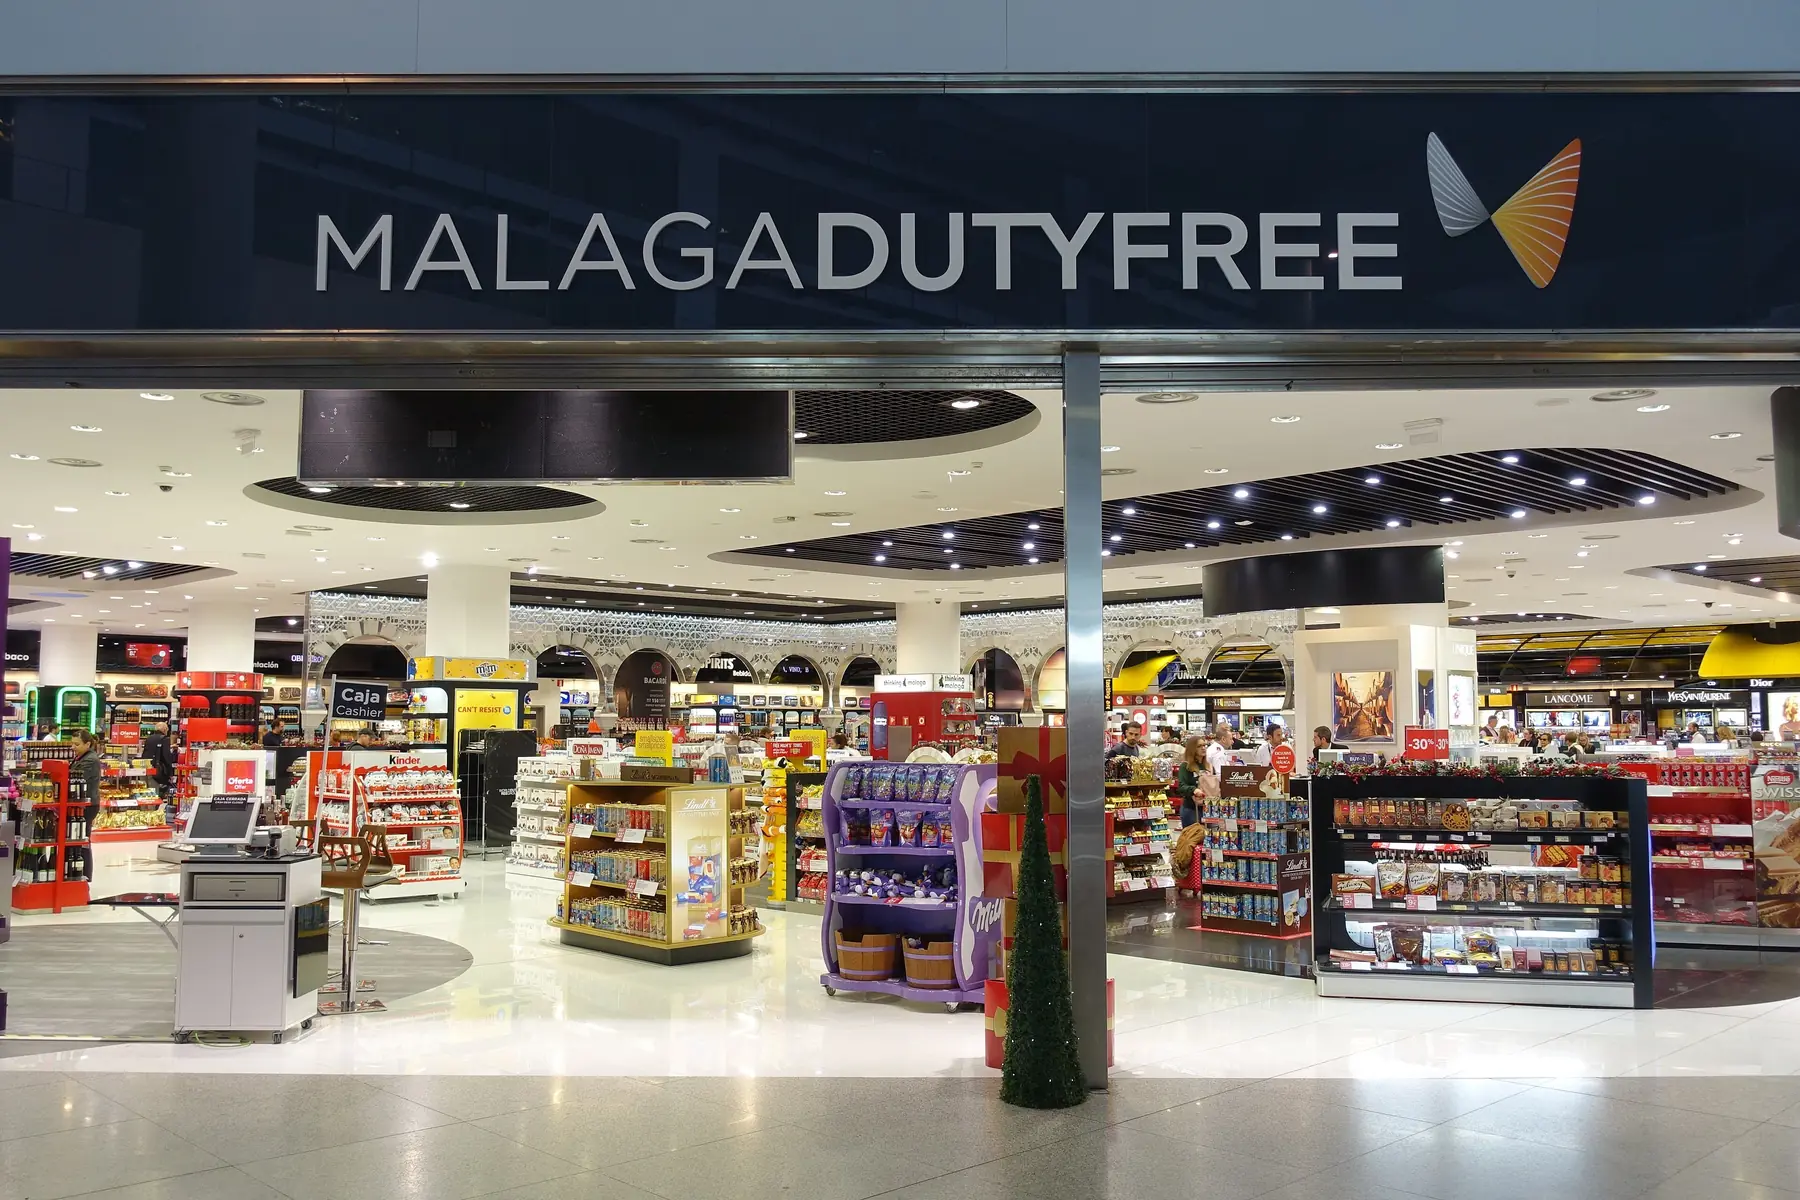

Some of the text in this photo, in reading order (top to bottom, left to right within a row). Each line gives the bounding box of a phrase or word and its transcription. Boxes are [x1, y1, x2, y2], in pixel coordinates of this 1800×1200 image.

[945, 675, 965, 683] thinking
[1750, 678, 1773, 687] Dior
[341, 688, 380, 705] Caja
[1544, 693, 1594, 703] LANCÔME
[335, 705, 383, 718] Cashier
[227, 777, 254, 785] Oferta
[1229, 771, 1249, 781] Lindt
[1754, 787, 1800, 798] SWISS
[683, 798, 709, 810] Lindt
[1284, 859, 1304, 871] Lindt
